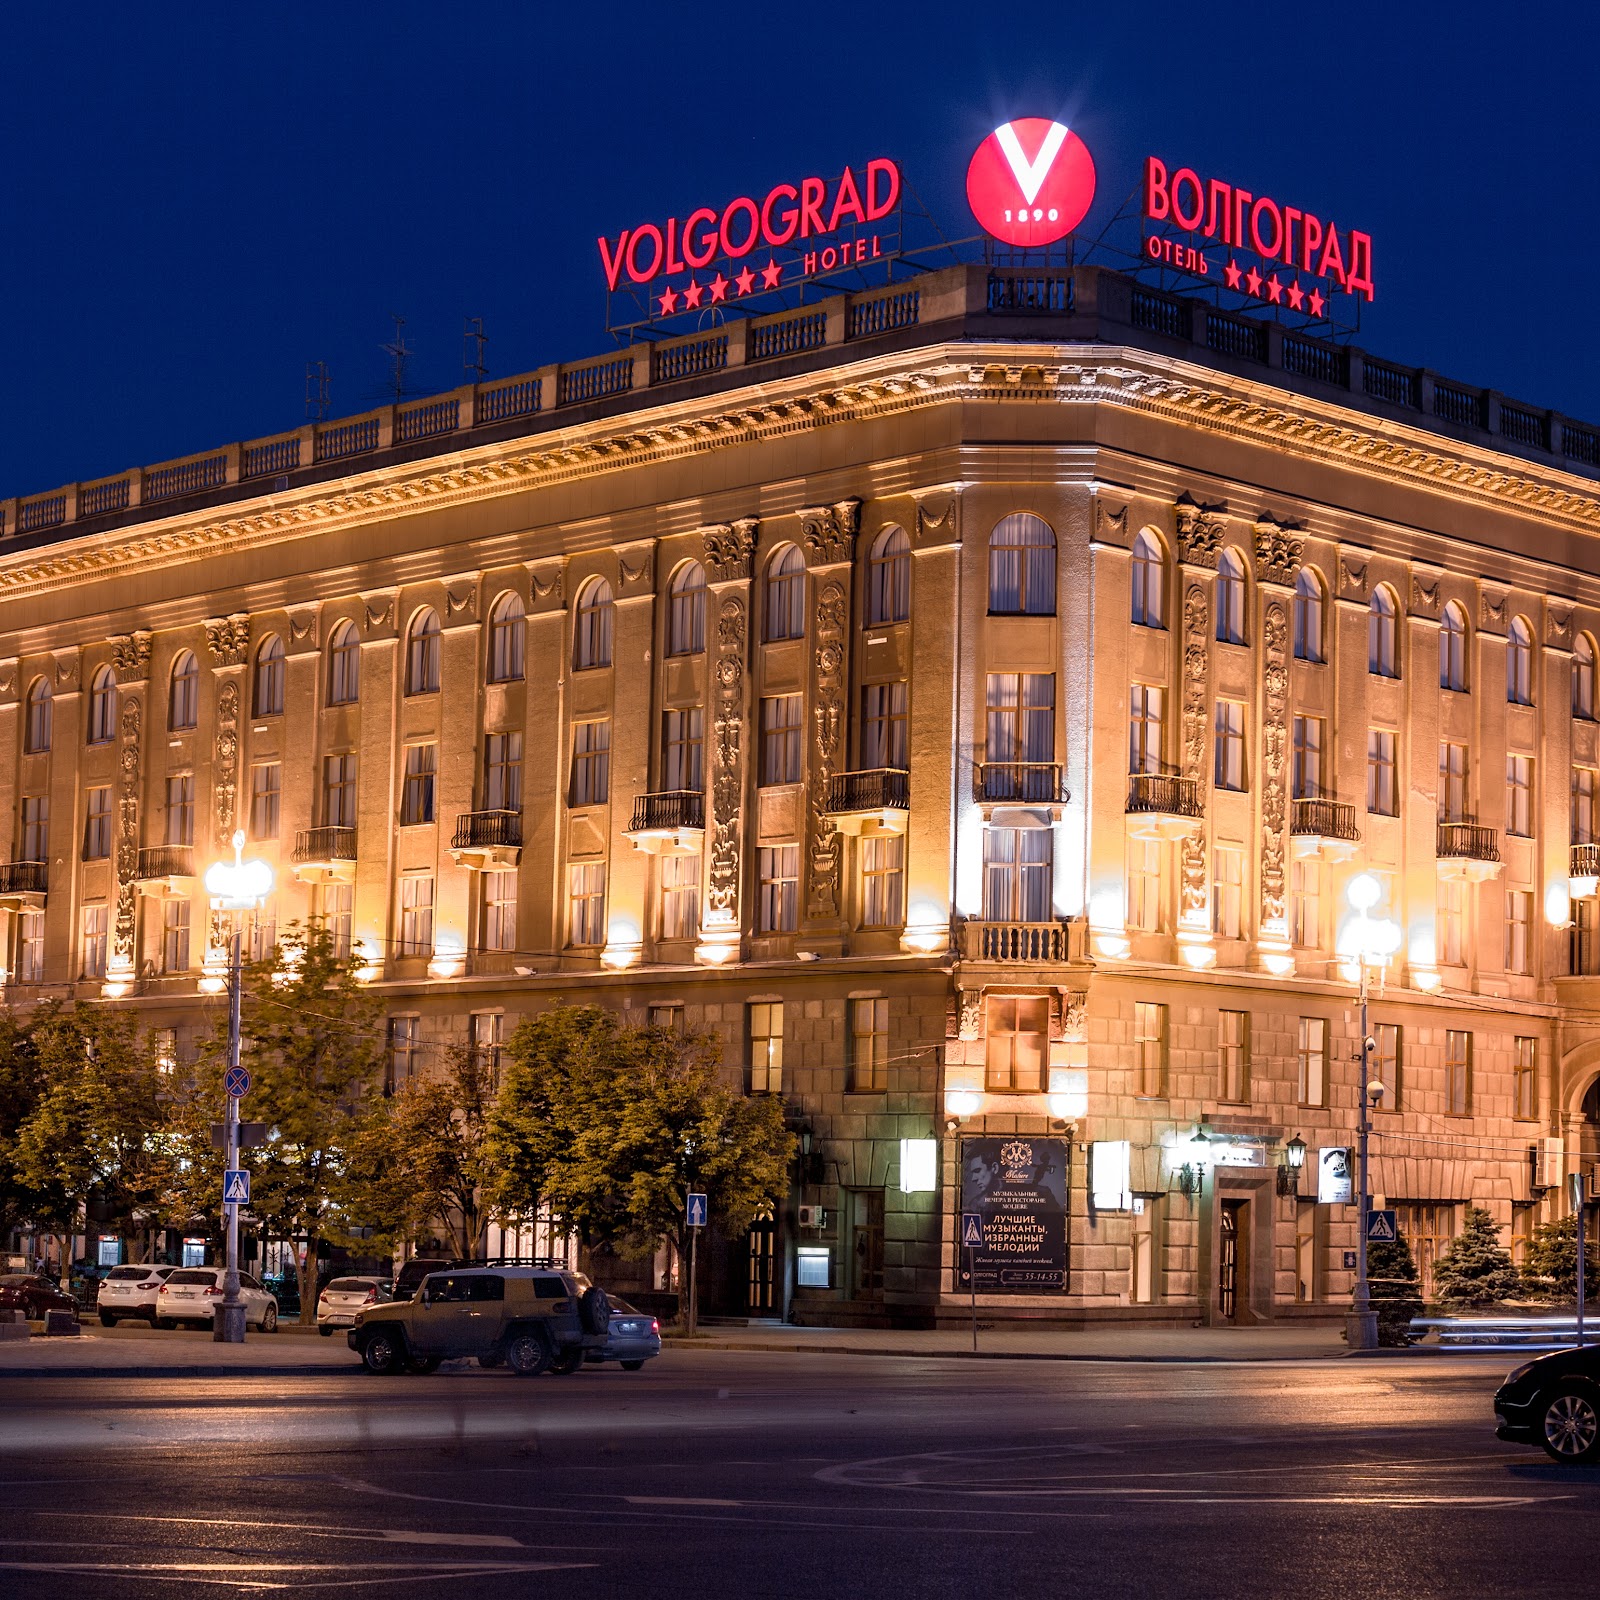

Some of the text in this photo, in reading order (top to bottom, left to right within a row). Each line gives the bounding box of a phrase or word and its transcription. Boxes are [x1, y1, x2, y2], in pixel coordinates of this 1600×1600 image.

[994, 121, 1069, 206] V
[1004, 207, 1059, 223] 1890
[597, 157, 902, 292] VOLGOGRAD
[1145, 156, 1374, 303] ВОЛГОГРАД
[803, 235, 882, 275] HOTEL
[1147, 235, 1208, 275] ОТЕЛЬ
[984, 1196, 1007, 1204] ВЕЧЕРА
[992, 1215, 1036, 1224] ЛУЧШИЕ
[983, 1224, 1048, 1235] МУЗЫКАНТЫ,
[984, 1233, 1044, 1243] ИЗБРАННЫЕ
[988, 1243, 1040, 1252] МЕЛОДИИ
[1024, 1272, 1058, 1281] 55-14-55
